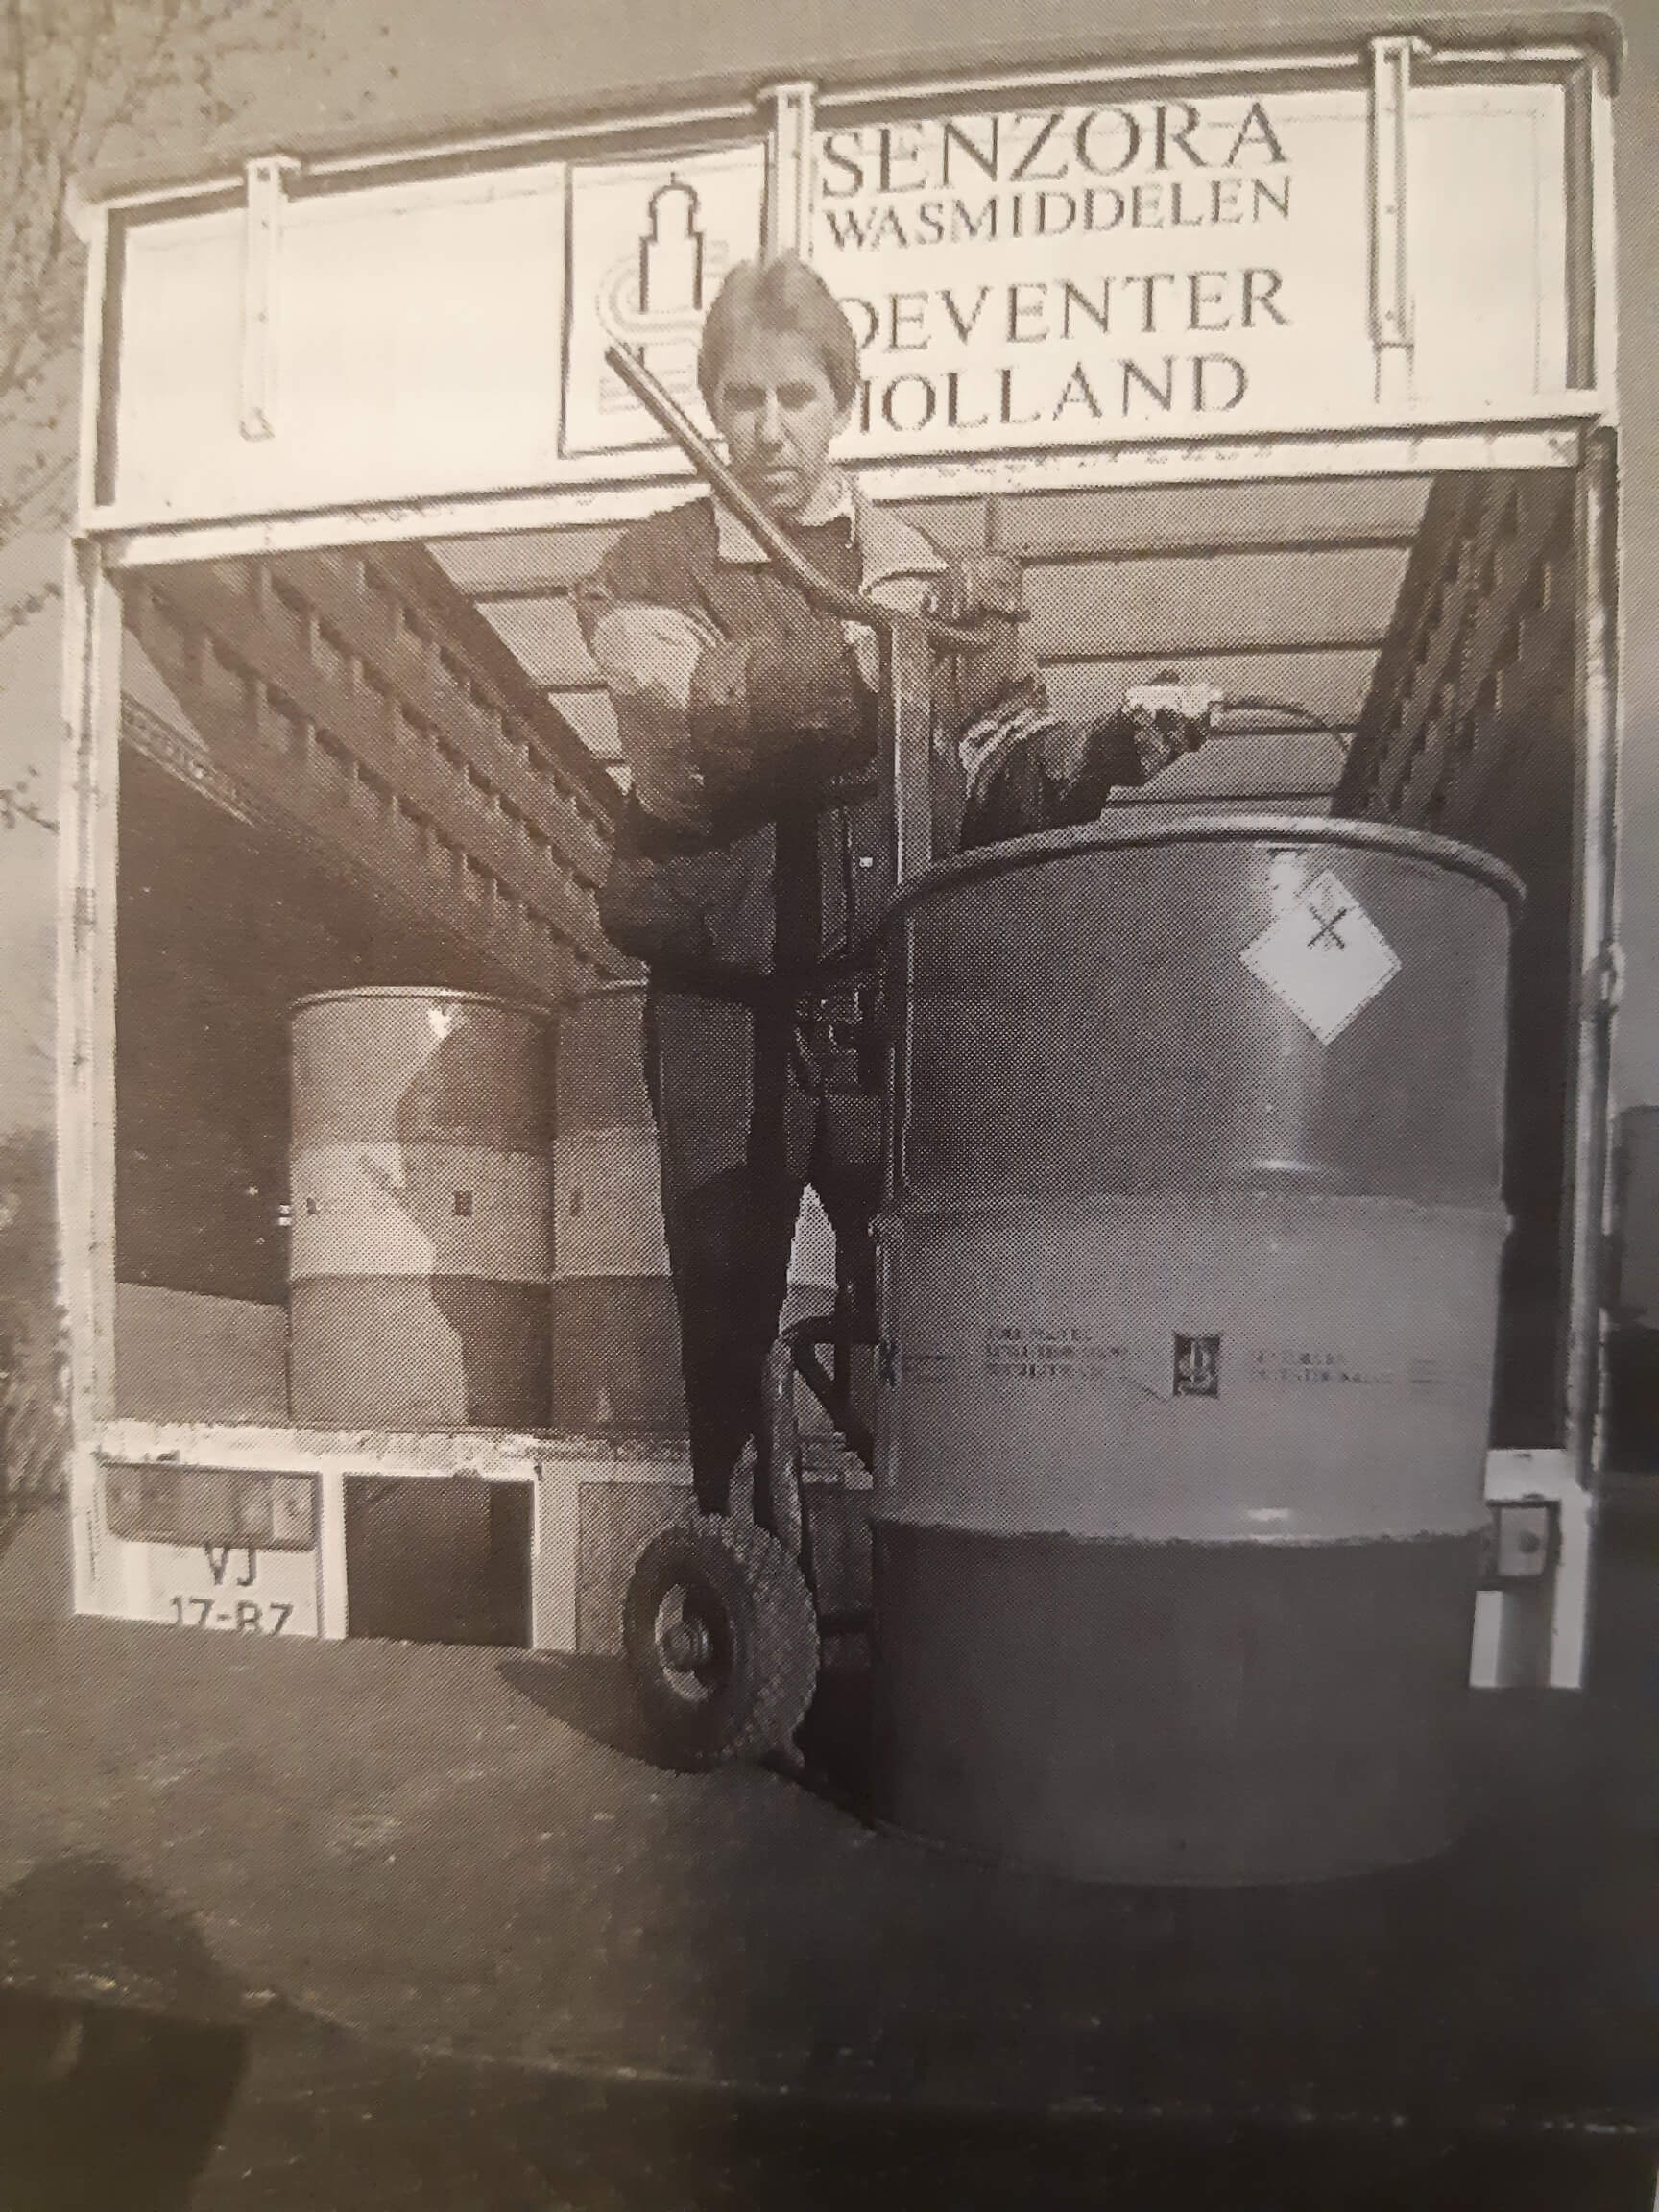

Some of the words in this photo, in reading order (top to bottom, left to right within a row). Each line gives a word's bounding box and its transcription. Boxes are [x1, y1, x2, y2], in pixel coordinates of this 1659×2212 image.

[822, 101, 1291, 199] SENZORA
[824, 175, 1292, 251] WASMIDDELEN
[838, 267, 1291, 351] DEVENTER
